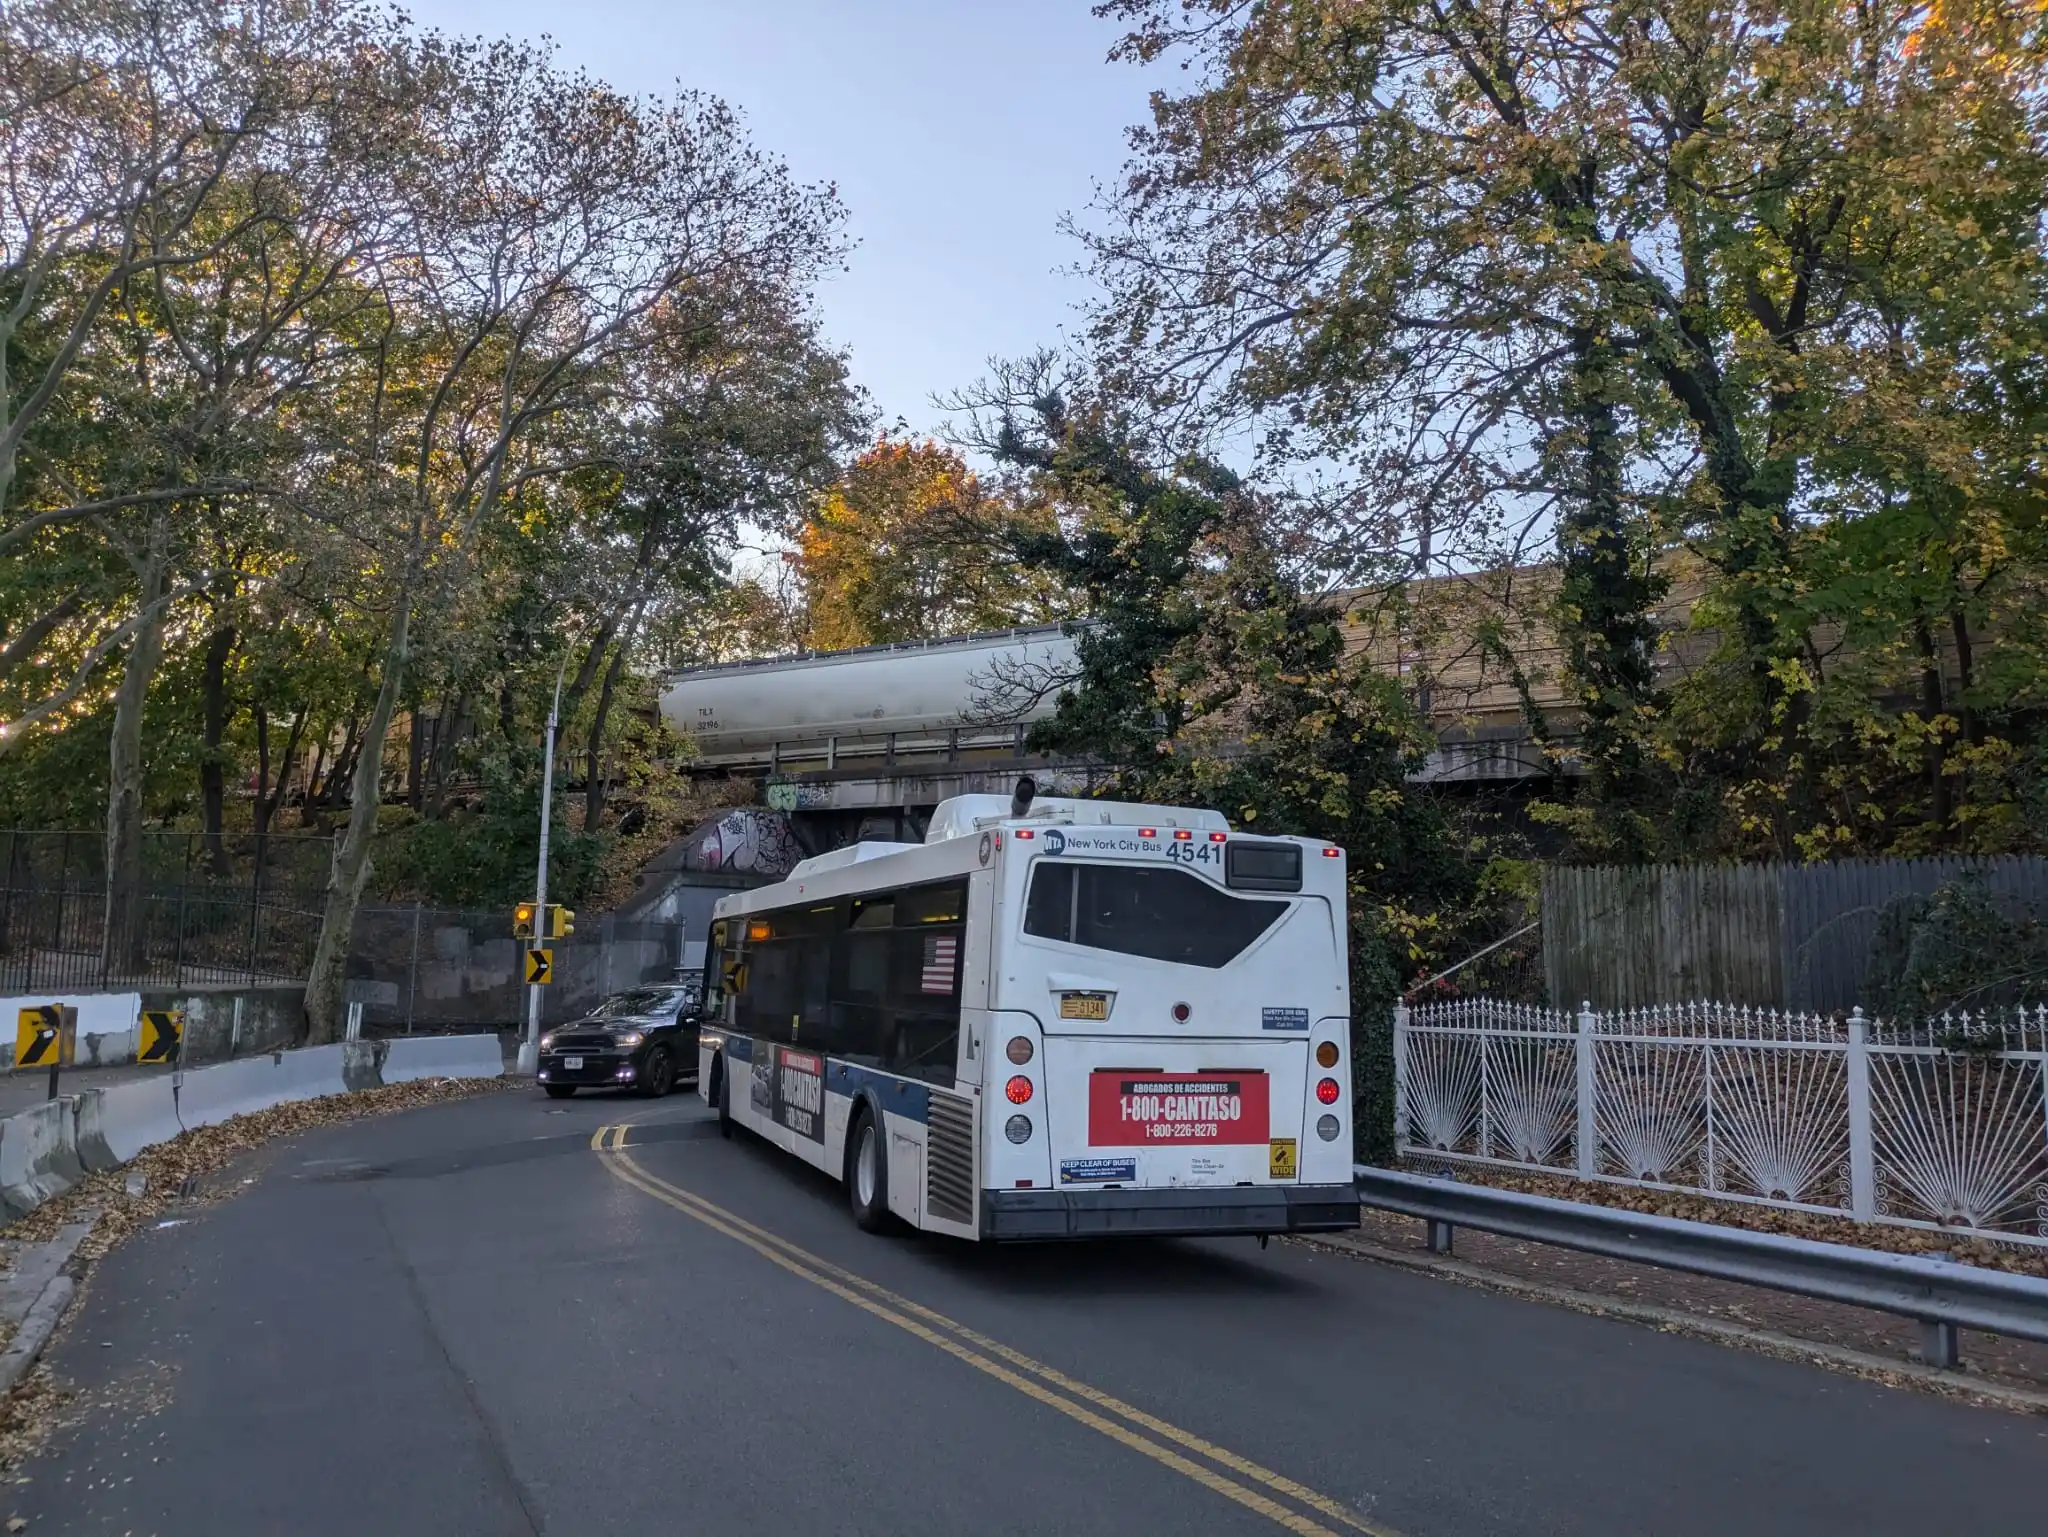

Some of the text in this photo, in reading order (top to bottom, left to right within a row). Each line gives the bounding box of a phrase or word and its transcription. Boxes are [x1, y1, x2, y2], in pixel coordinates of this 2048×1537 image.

[1044, 832, 1064, 852] MTA
[1067, 837, 1162, 853] New York City Bus
[1166, 841, 1220, 864] 4541
[1133, 1083, 1229, 1093] ABOGADOS DE ACCIDENTES
[1120, 1095, 1241, 1121] 1-800-CANTASO
[1145, 1123, 1217, 1138] 1-800-226-8276
[1061, 1158, 1135, 1168] KEEP CLEAR OF BUSES
[1271, 1166, 1296, 1175] WIDE
